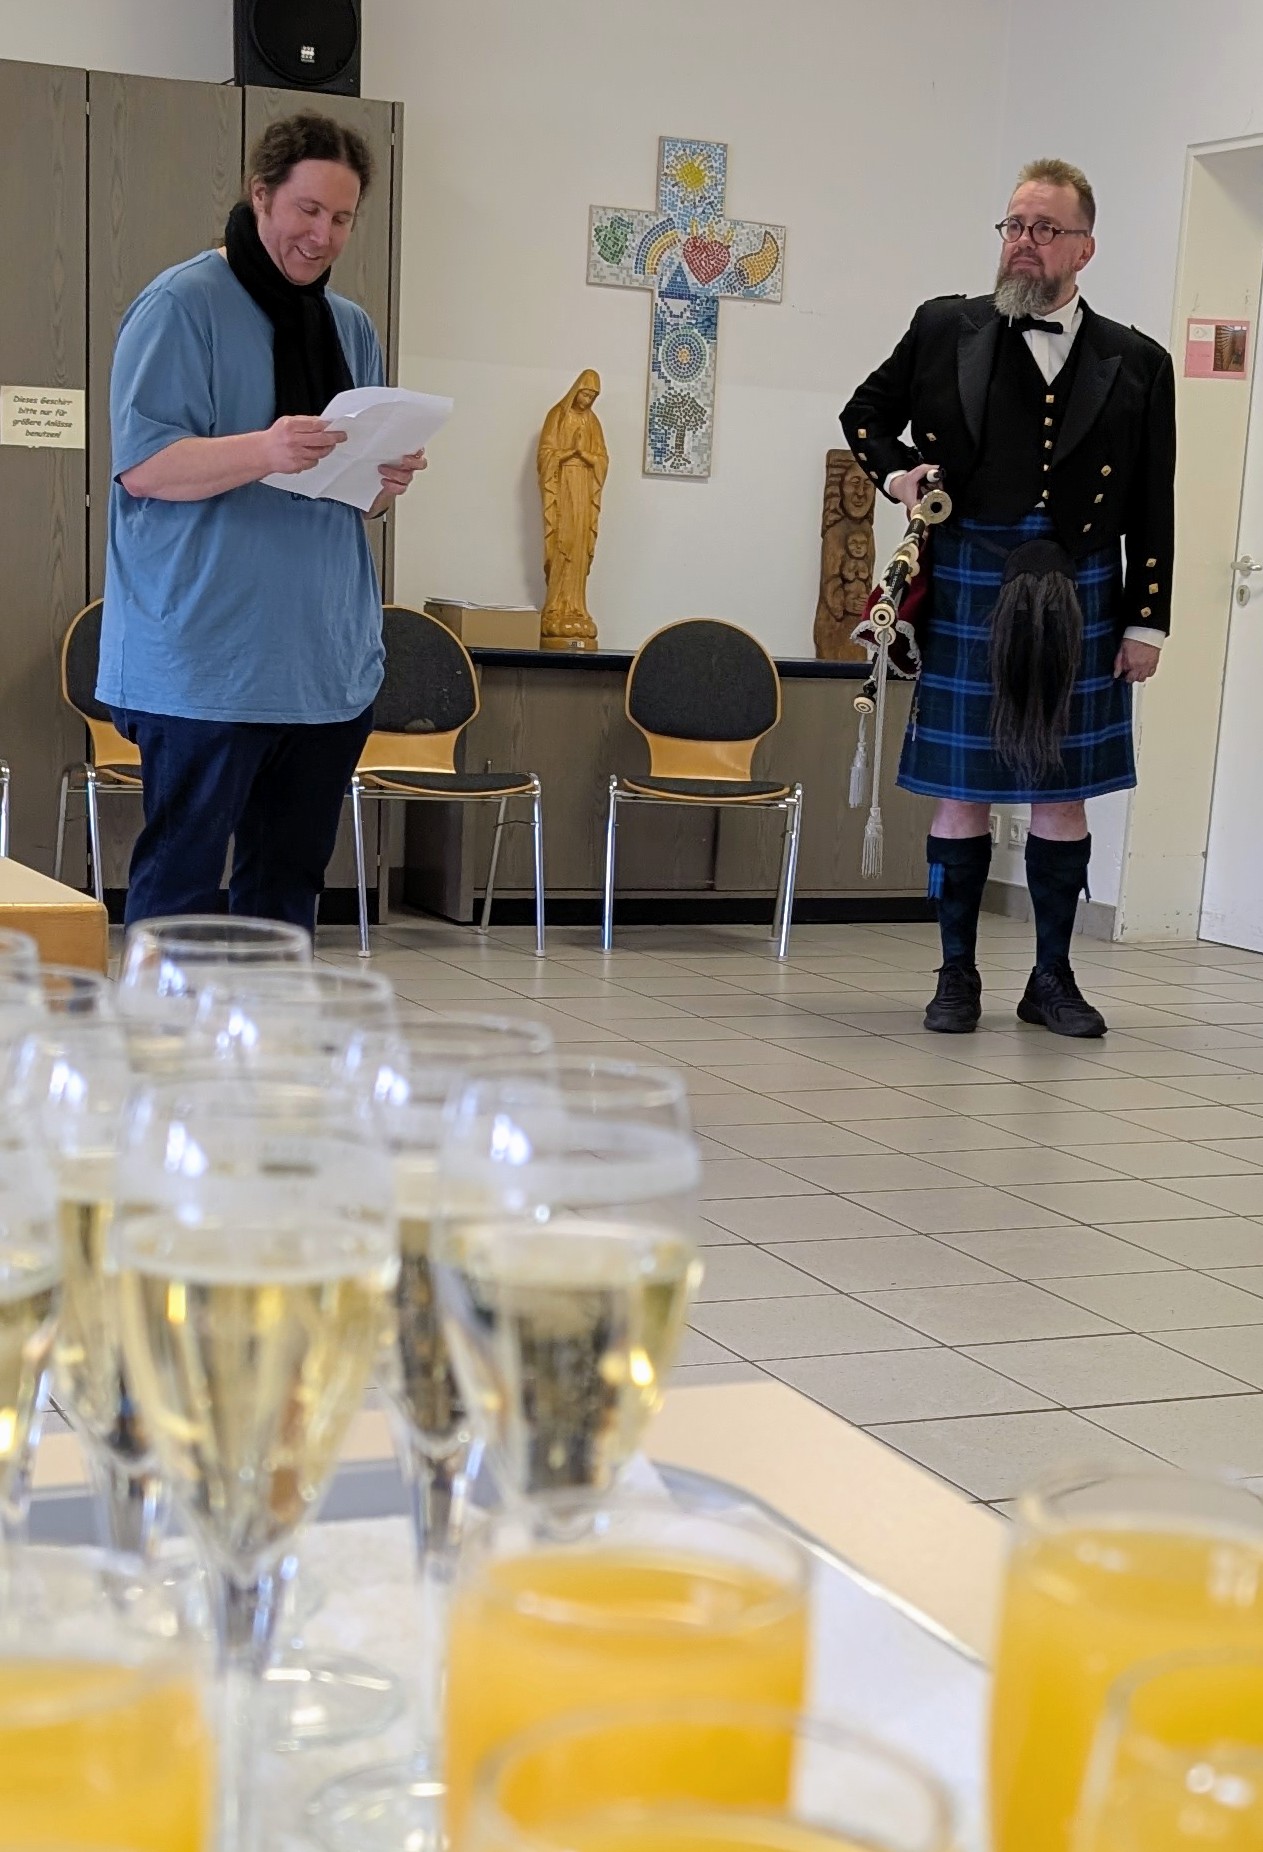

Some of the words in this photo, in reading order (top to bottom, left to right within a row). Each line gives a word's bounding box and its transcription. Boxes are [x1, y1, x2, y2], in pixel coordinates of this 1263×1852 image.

[13, 395, 38, 404] Dieses
[40, 396, 73, 406] Geschirr
[18, 407, 37, 415] bitte
[55, 408, 68, 417] für
[12, 418, 42, 427] größere
[44, 419, 73, 429] Anlässe
[25, 429, 62, 438] benutzen!
